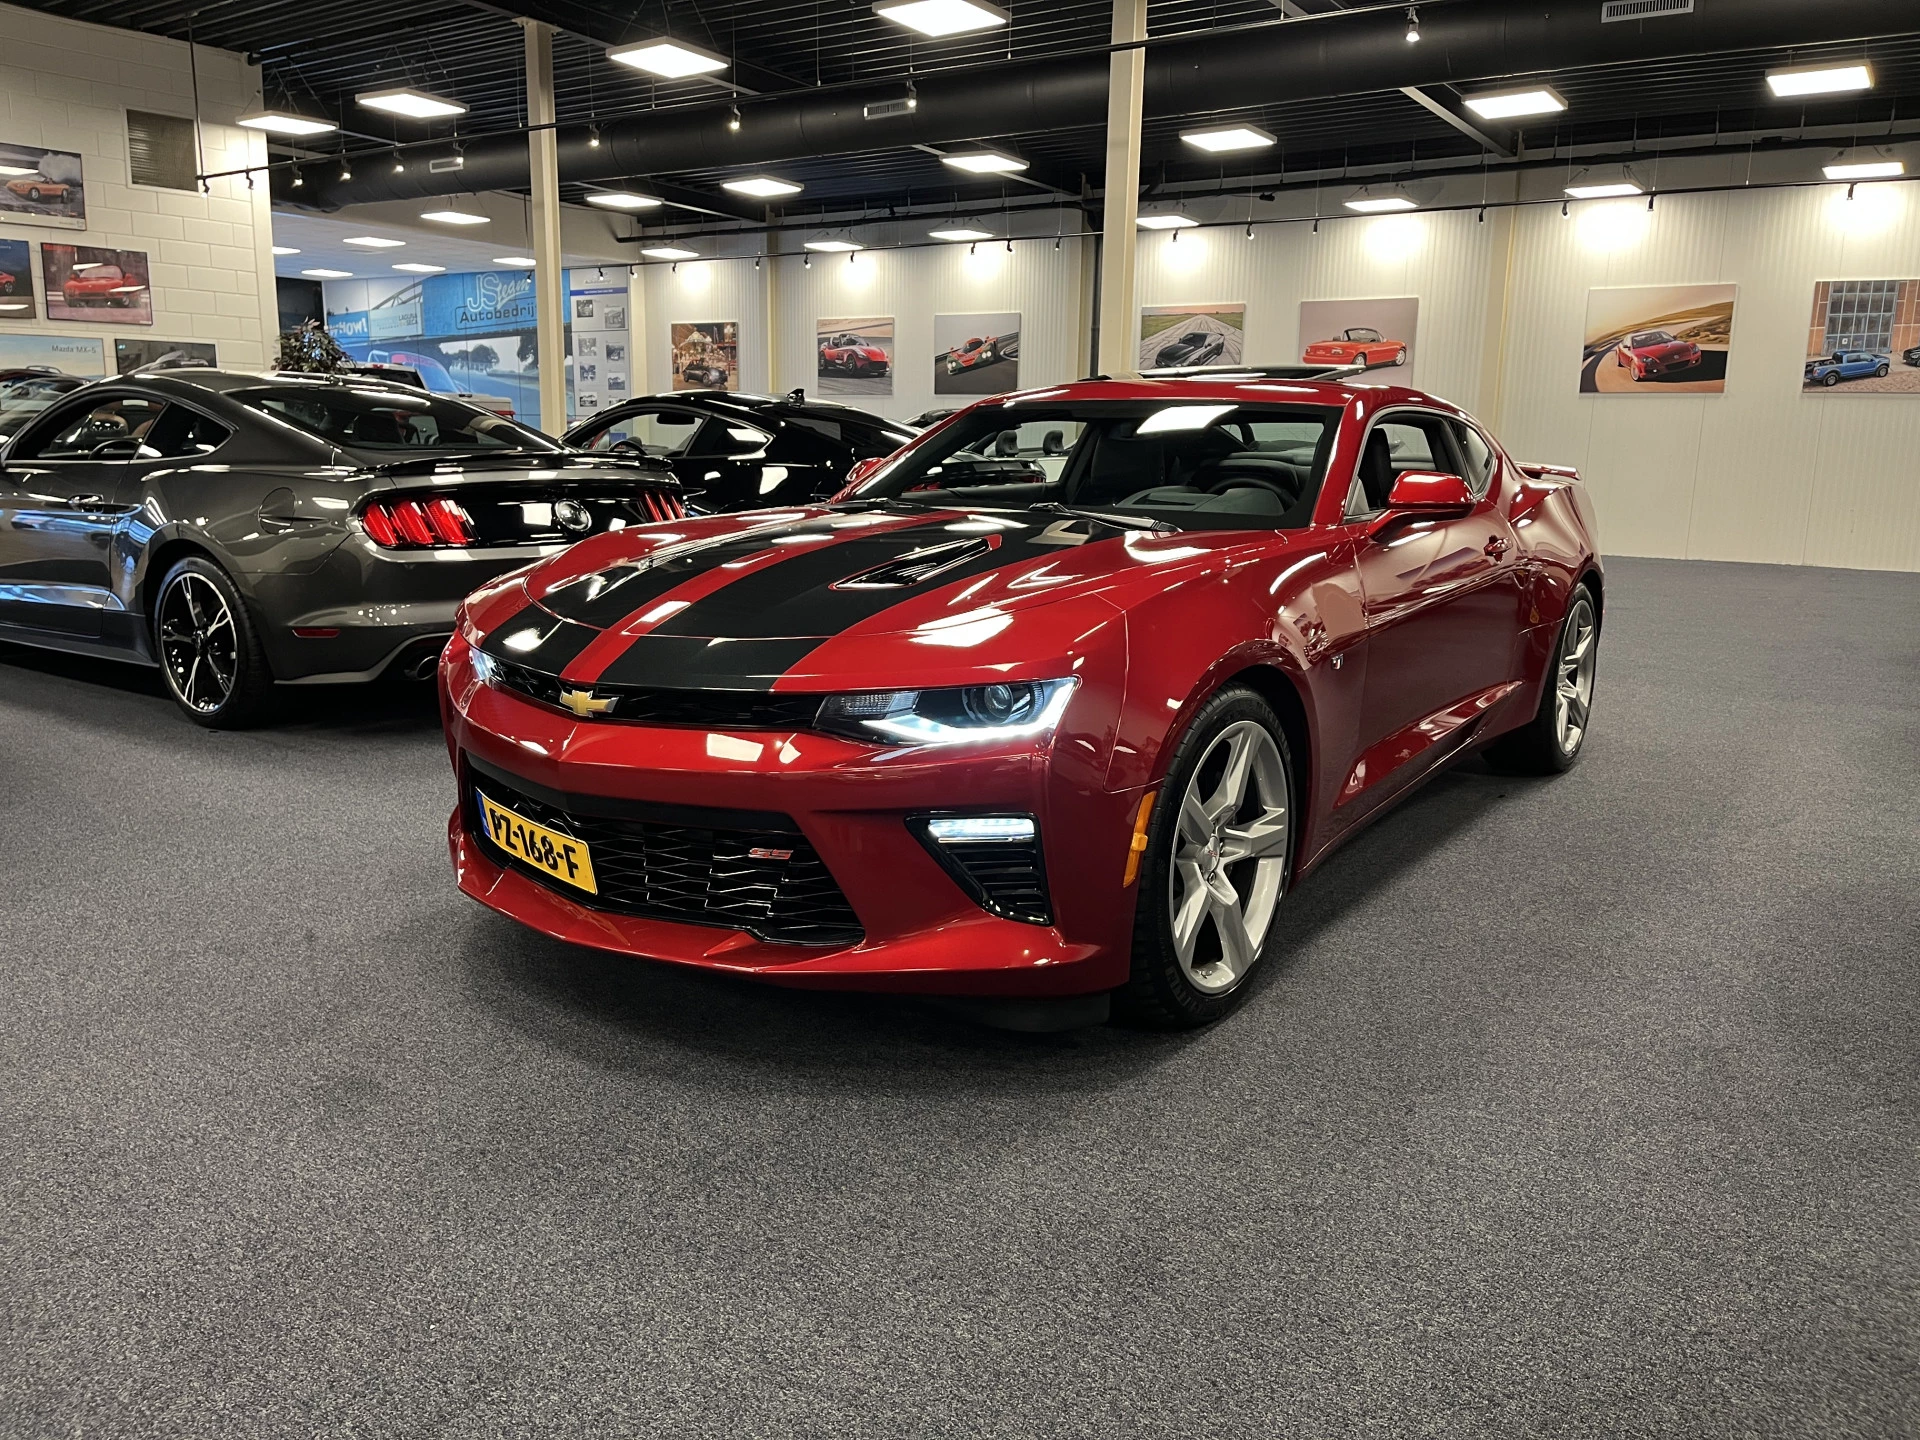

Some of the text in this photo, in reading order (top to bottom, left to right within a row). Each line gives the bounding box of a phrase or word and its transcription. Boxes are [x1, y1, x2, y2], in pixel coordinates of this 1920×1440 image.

[460, 303, 537, 323] Autobedrij
[51, 345, 97, 354] Mazda MX-5
[489, 807, 579, 879] PZ-168-F
[748, 847, 794, 860] SS
